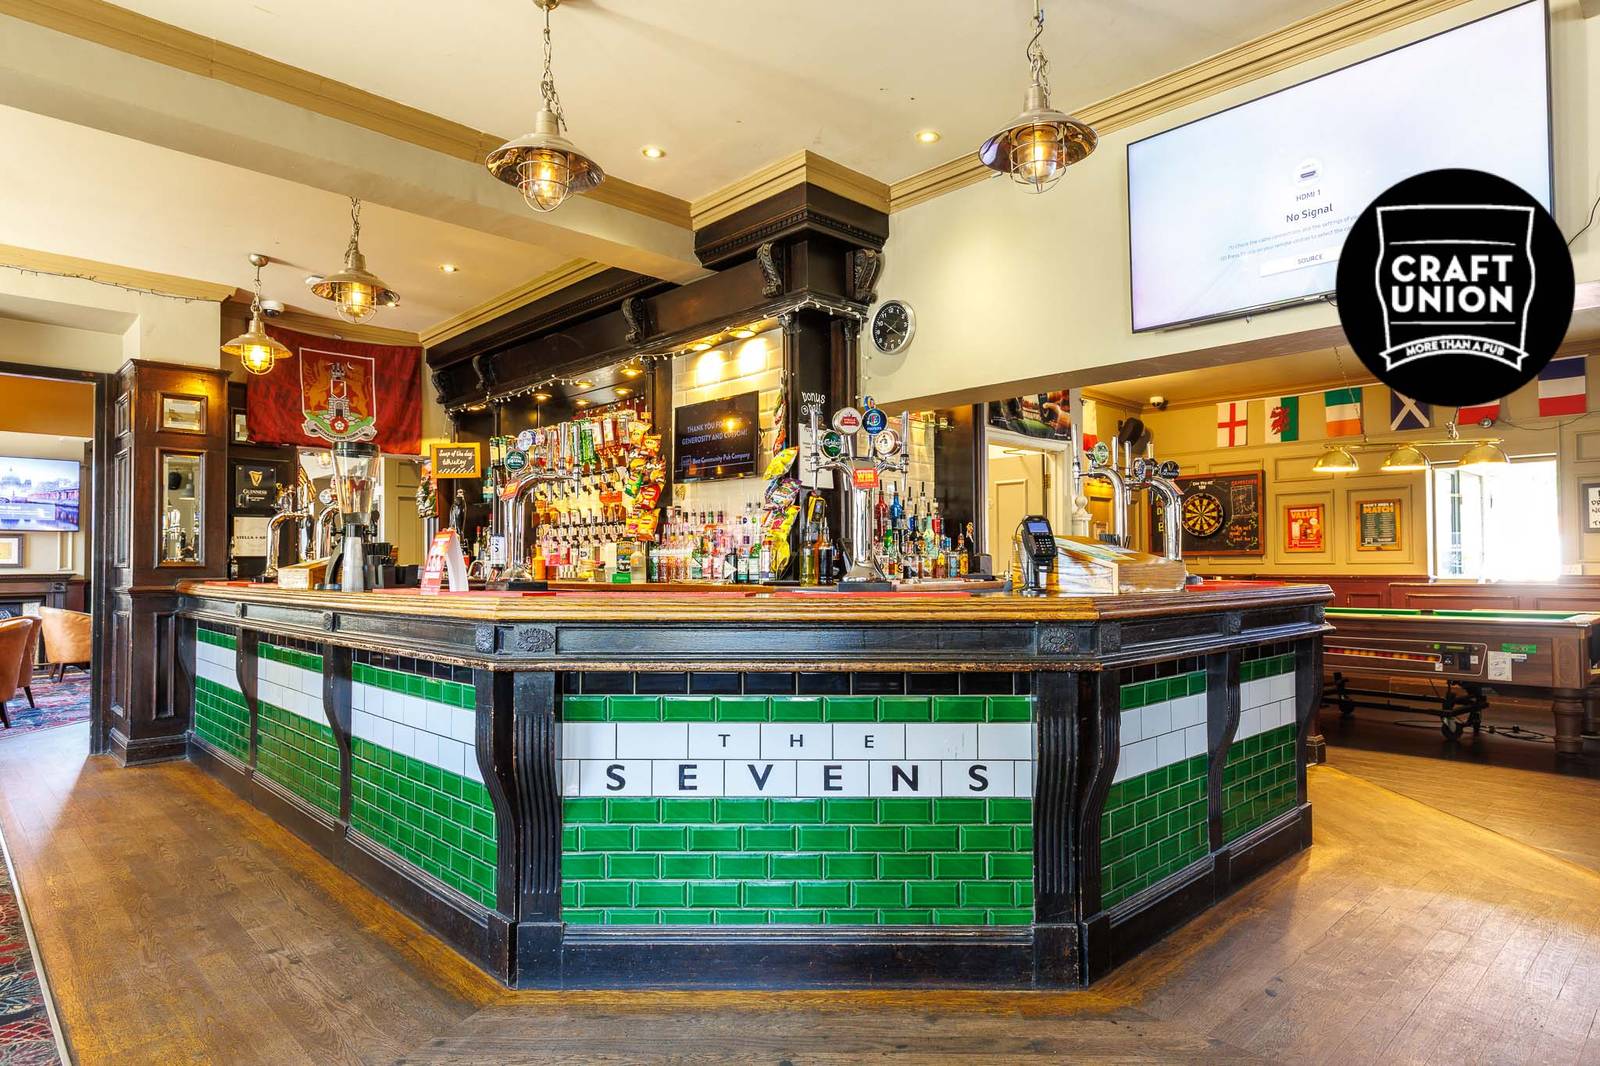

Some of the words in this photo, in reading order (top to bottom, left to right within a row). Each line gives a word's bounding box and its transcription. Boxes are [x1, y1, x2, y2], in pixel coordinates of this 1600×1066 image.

[1296, 191, 1315, 202] HDMI
[1286, 214, 1300, 223] No
[1301, 203, 1333, 219] Signal
[1297, 254, 1323, 265] SOURCE
[801, 391, 826, 404] bonus
[687, 424, 704, 434] THANK
[704, 421, 715, 430] YOU
[682, 434, 711, 446] GENEROSITY
[718, 733, 875, 750] THE
[605, 764, 989, 792] SEVENS
